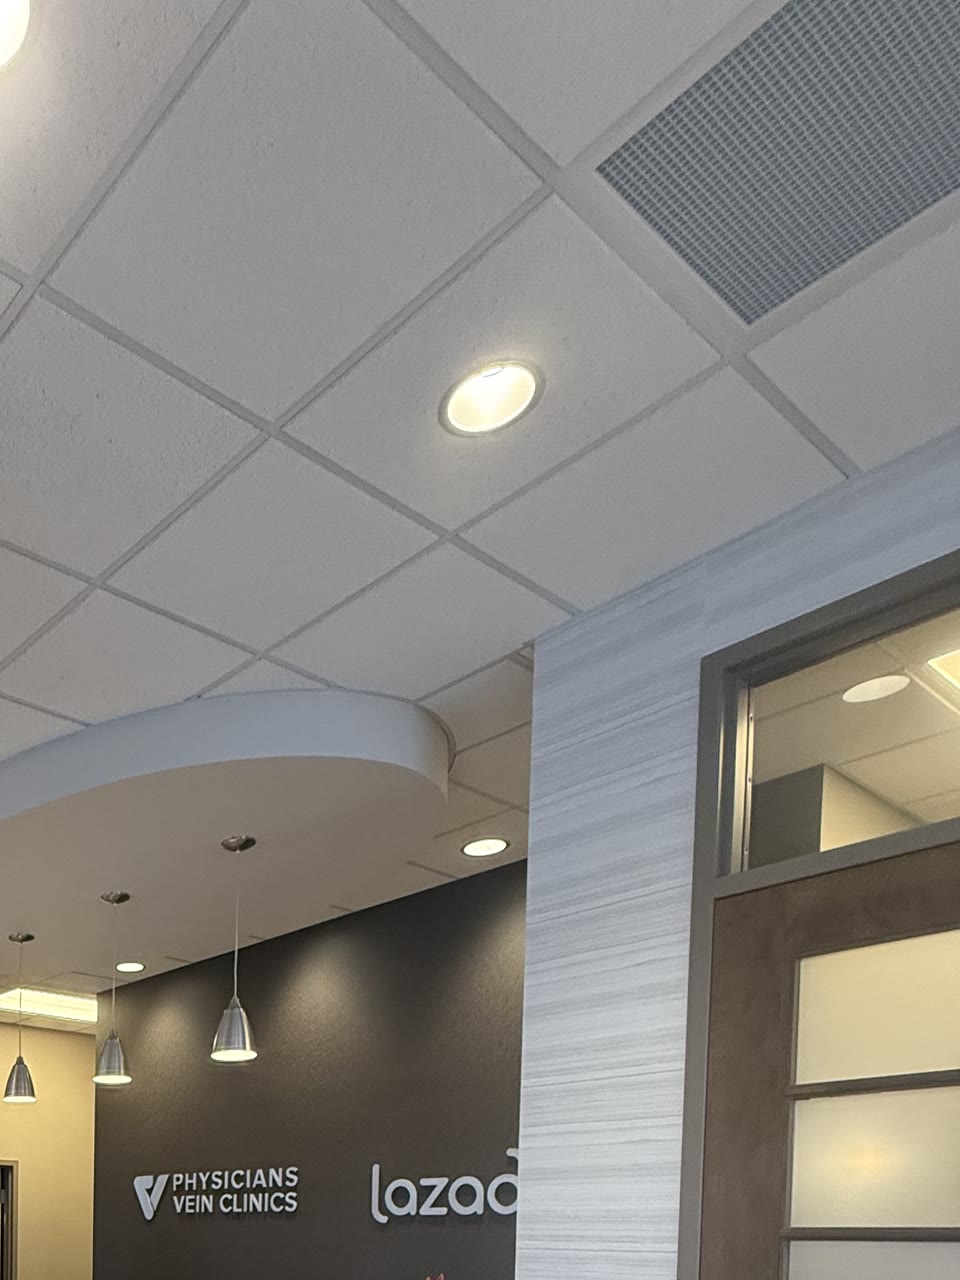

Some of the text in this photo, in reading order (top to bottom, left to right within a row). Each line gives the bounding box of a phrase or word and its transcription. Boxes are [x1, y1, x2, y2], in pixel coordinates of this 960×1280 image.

[172, 1166, 299, 1192] PHYSICIANS
[173, 1191, 298, 1213] VEIN CLINICS
